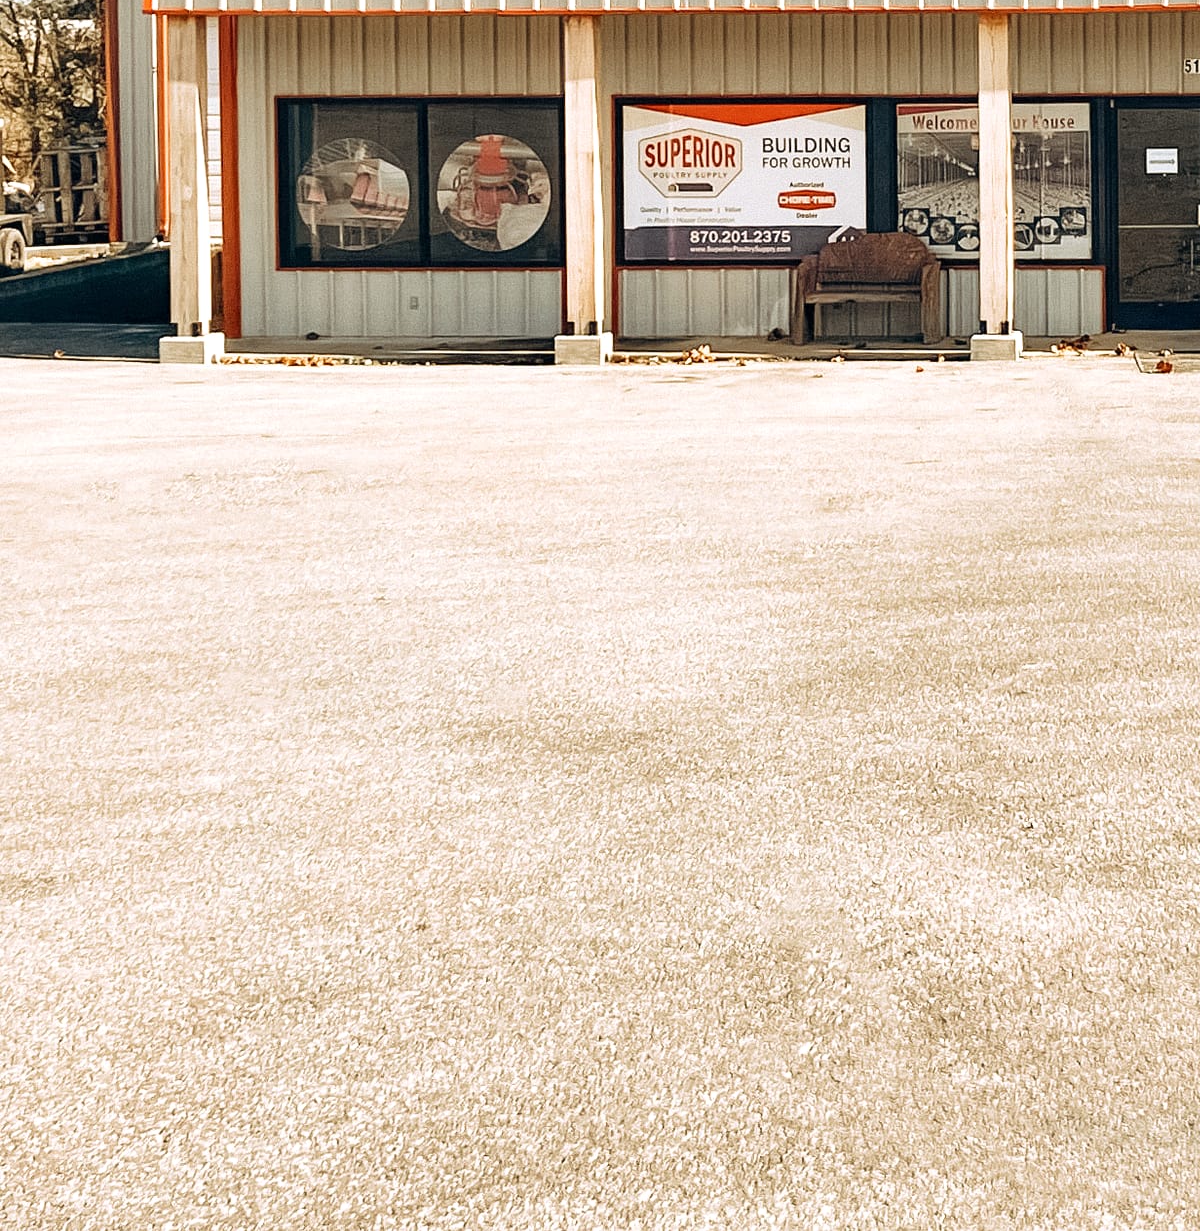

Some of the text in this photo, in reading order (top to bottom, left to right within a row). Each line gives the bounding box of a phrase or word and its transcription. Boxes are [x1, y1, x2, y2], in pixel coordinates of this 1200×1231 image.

[912, 115, 1075, 131] Welcome ur House
[645, 135, 736, 168] SUPERIOR
[762, 137, 851, 153] BUILDING
[762, 157, 851, 168] FOR GROWTH
[690, 230, 791, 243] 870.201.2375
